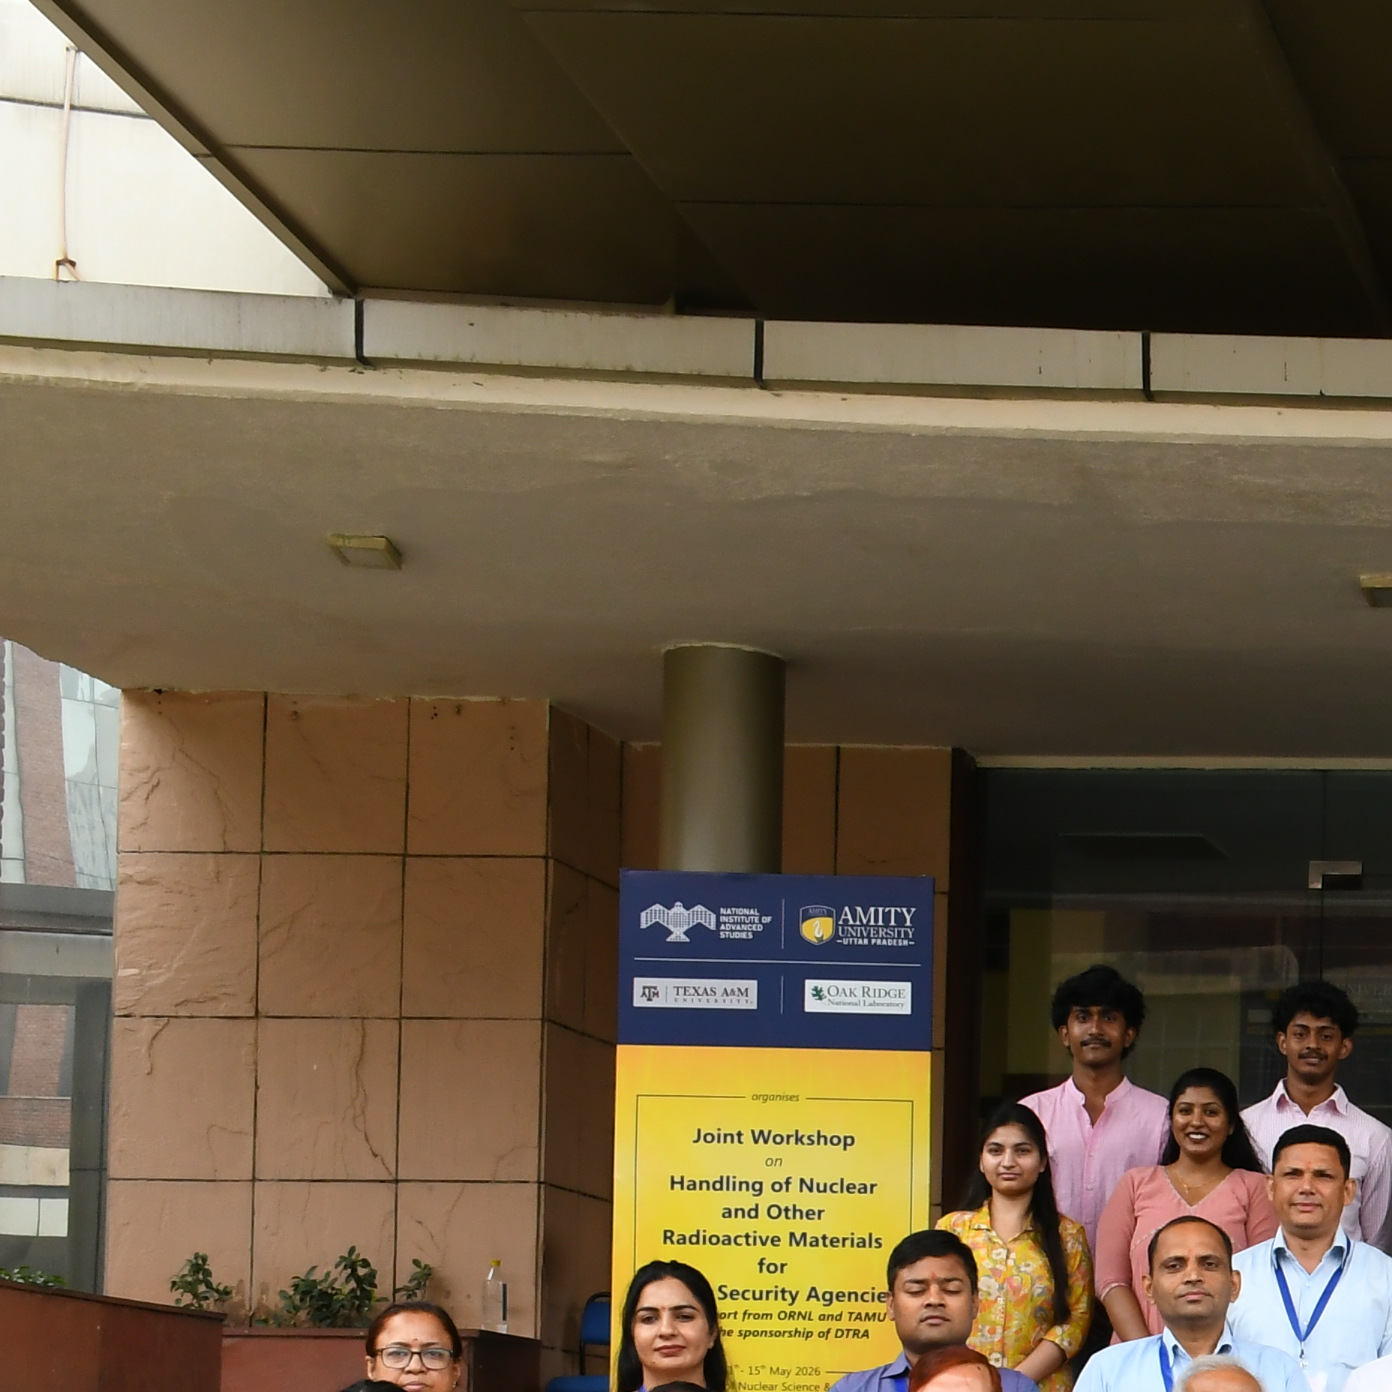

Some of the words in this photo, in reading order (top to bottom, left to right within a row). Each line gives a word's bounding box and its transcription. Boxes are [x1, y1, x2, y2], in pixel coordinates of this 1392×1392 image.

[719, 907, 760, 915] NATIONAL
[838, 906, 917, 926] AMITY
[719, 931, 753, 939] STUDIES
[838, 926, 915, 938] UNIVERSITY
[871, 938, 908, 946] PRADESH
[673, 986, 717, 997] TEXAS
[721, 987, 749, 998] A&M
[827, 985, 857, 998] OAK
[861, 986, 906, 999] RIDGE
[828, 999, 860, 1007] National
[863, 999, 904, 1009] Laboratory
[751, 1093, 800, 1104] organises
[692, 1128, 744, 1145] Joint
[751, 1129, 856, 1151] Workshop
[765, 1156, 783, 1167] on
[669, 1175, 764, 1196] Handling
[770, 1177, 793, 1192] of
[799, 1177, 878, 1194] Nuclear
[721, 1203, 759, 1219] and
[766, 1204, 825, 1220] Other
[662, 1229, 781, 1247] Radioactive
[788, 1231, 883, 1249] Materials
[757, 1257, 788, 1274] for
[718, 1284, 800, 1306] Security
[806, 1286, 888, 1307] Agencie
[741, 1309, 773, 1322] from
[777, 1310, 814, 1321] ORNL
[818, 1311, 843, 1322] and
[847, 1311, 887, 1322] TAMU
[737, 1327, 814, 1341] sponsorship
[817, 1328, 832, 1341] of
[834, 1328, 870, 1339] DTRA
[769, 1366, 792, 1378] May
[795, 1366, 821, 1376] 2026
[738, 1381, 778, 1391] Nuclear
[781, 1381, 820, 1392] Science
